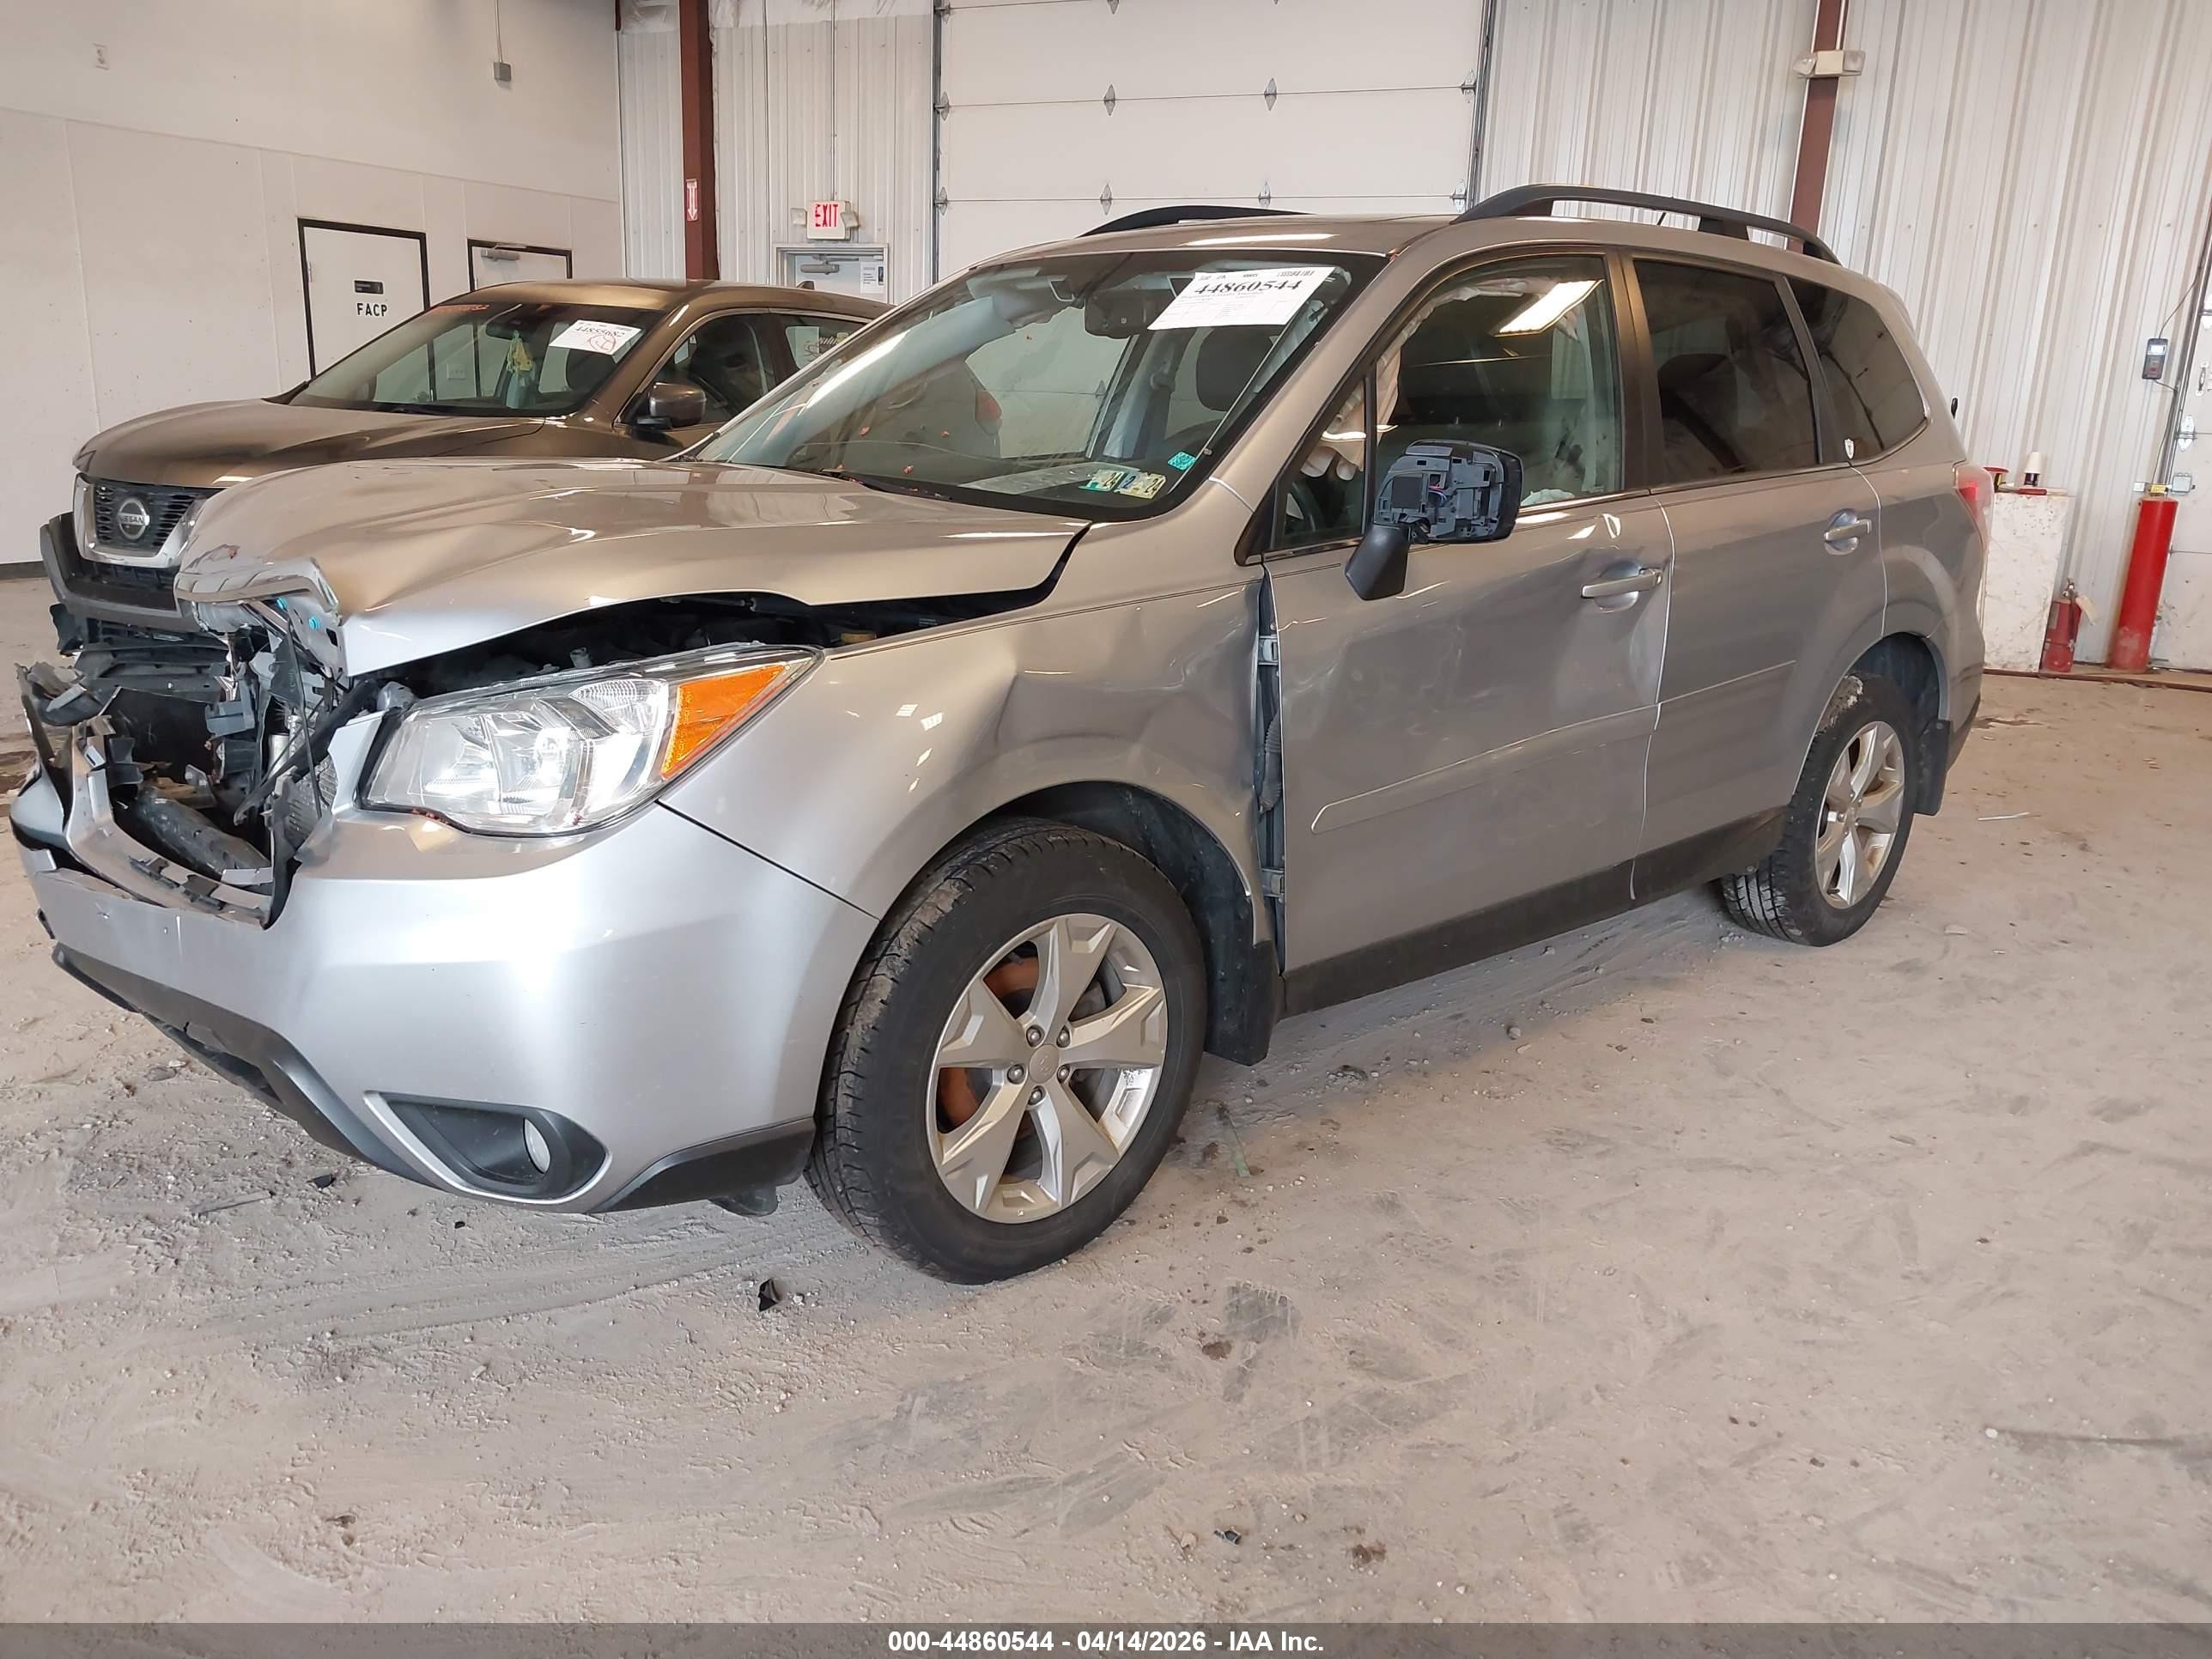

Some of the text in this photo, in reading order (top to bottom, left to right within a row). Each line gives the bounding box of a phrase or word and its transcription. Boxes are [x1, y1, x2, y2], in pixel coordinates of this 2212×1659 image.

[815, 204, 839, 228] EXIT
[1194, 278, 1304, 295] 44860544
[356, 302, 388, 317] FACP
[1103, 471, 1120, 488] 24
[1145, 477, 1164, 495] 24
[118, 514, 144, 523] SSAN
